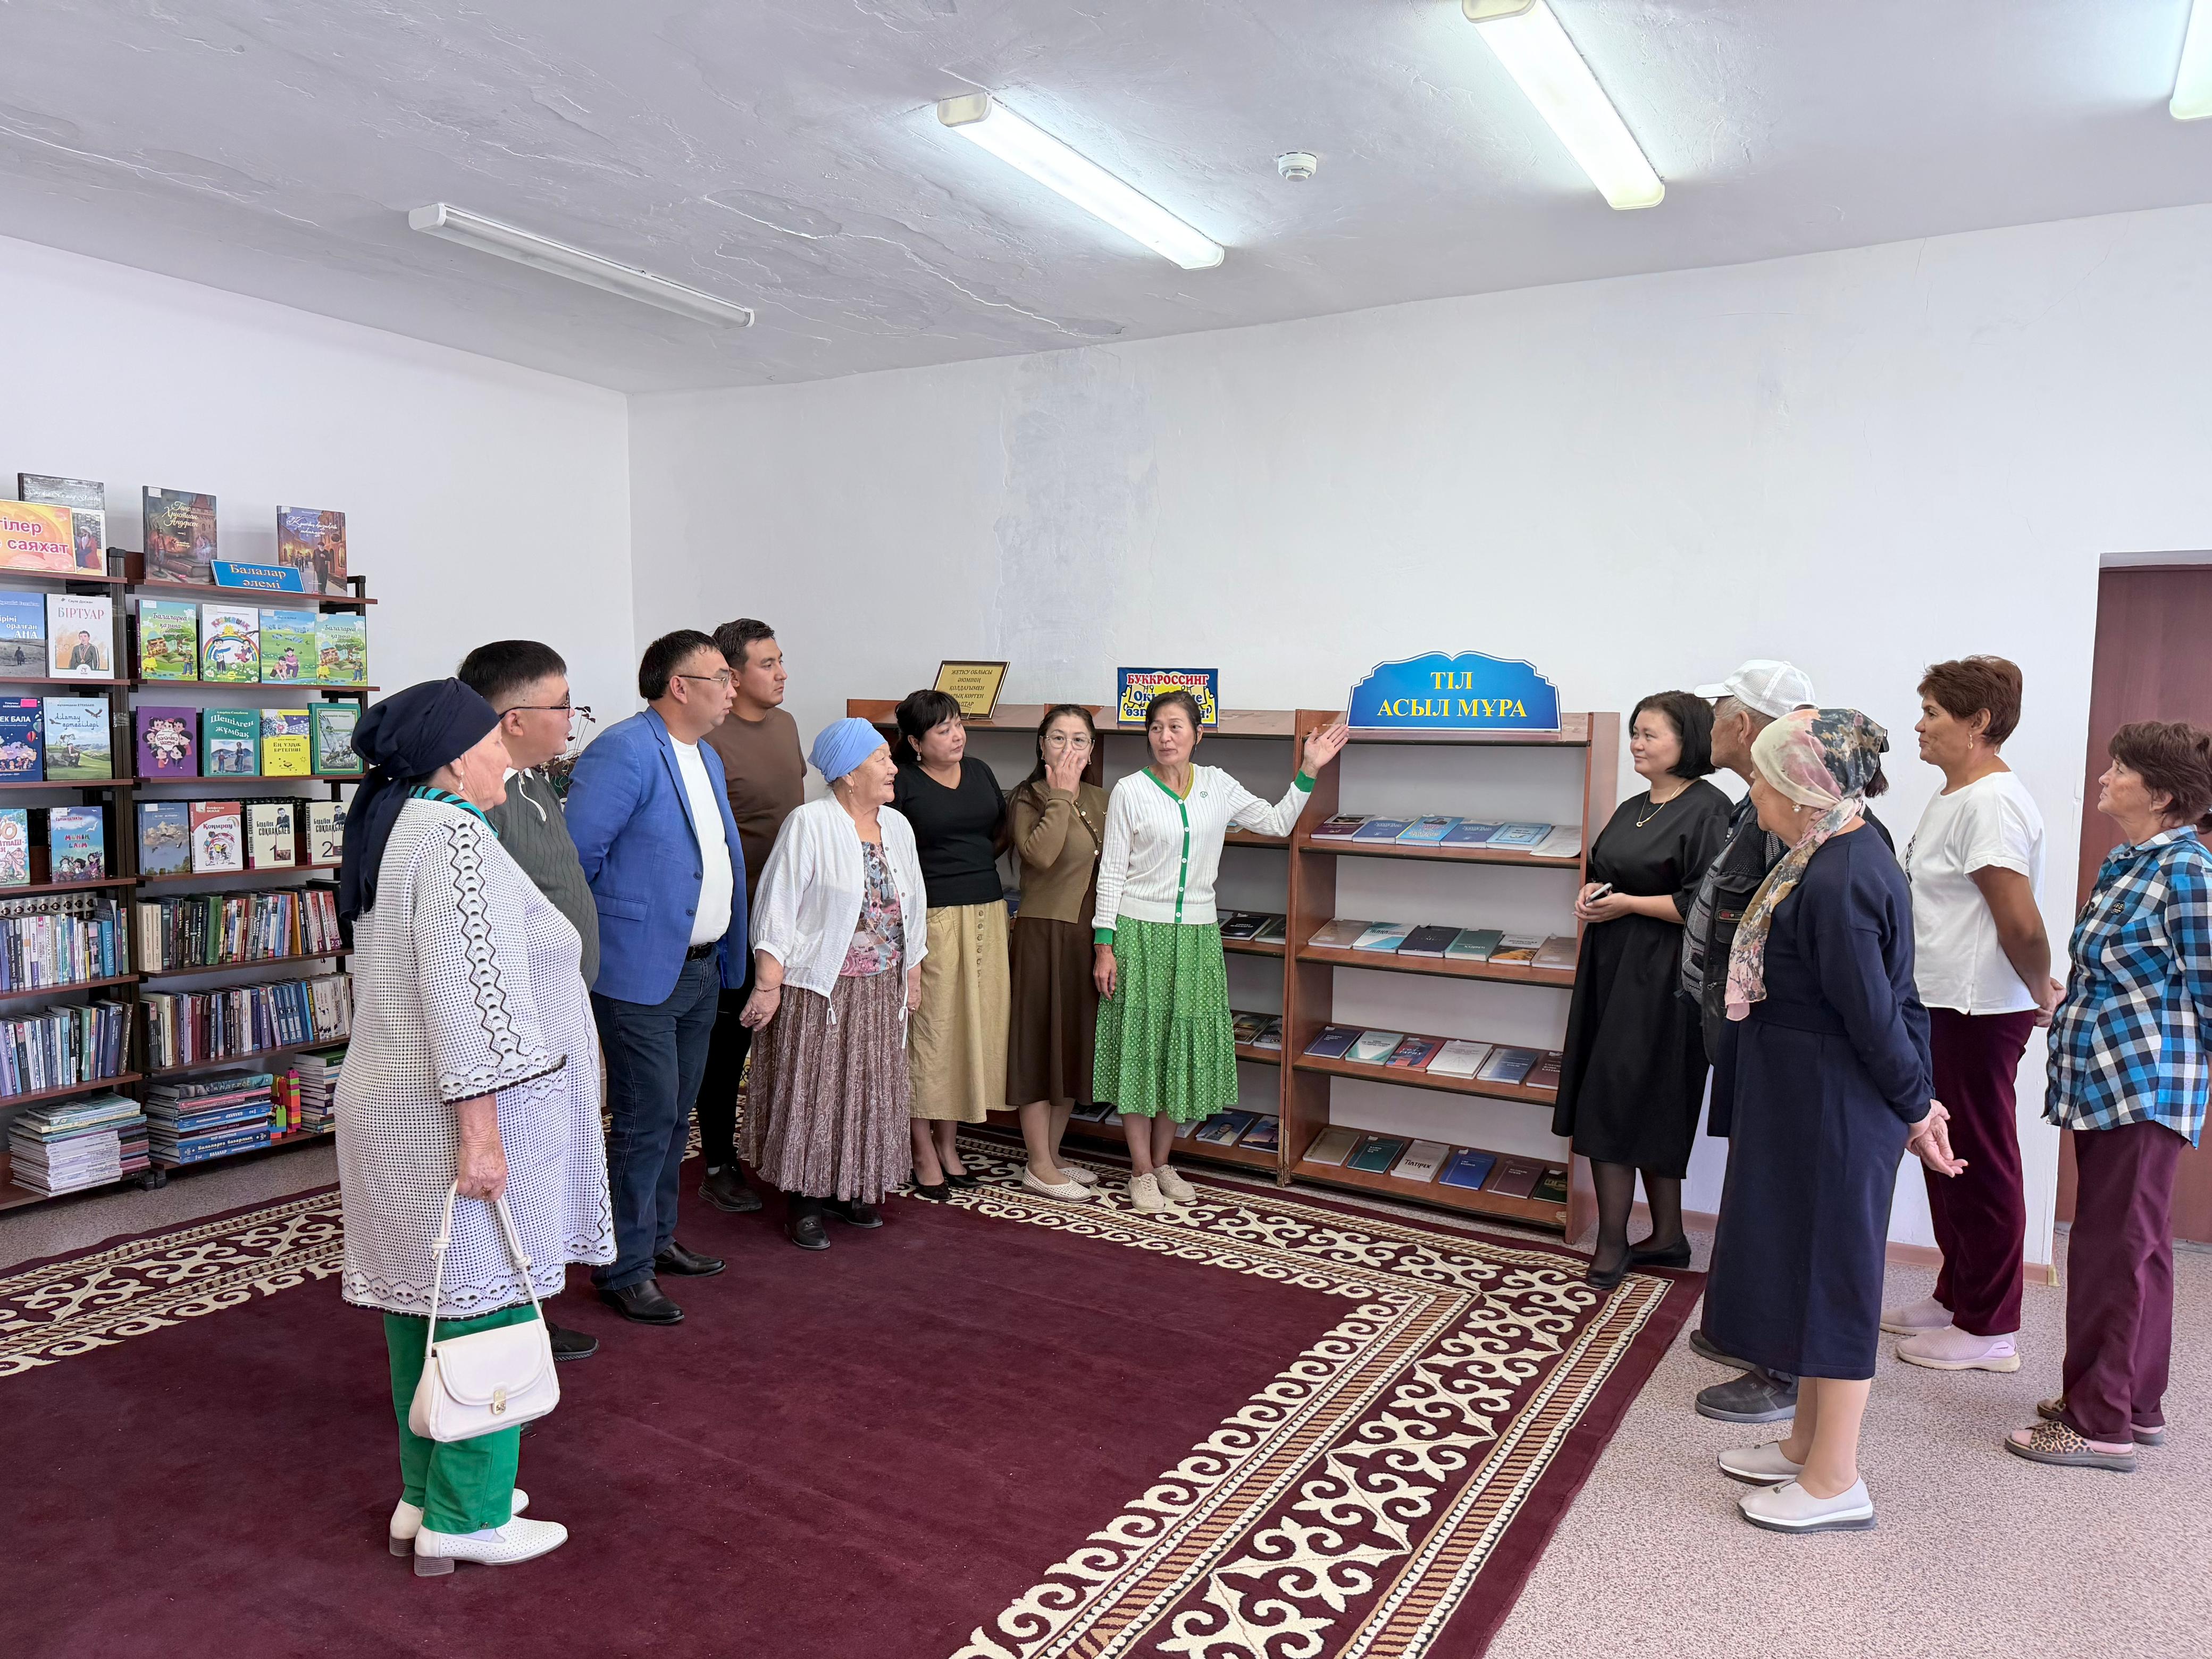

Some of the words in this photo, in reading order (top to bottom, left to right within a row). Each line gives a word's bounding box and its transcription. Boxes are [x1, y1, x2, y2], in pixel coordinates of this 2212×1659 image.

[7, 539, 68, 554] саяхат
[229, 564, 286, 580] Балалар
[242, 580, 281, 589] әлемі
[58, 607, 104, 619] БІРТУАР
[1127, 674, 1209, 685] БУККРОССИНГ
[1430, 672, 1474, 690] ТІЛ
[1377, 699, 1450, 717] АСЫЛ
[1456, 699, 1528, 717] МҰРА
[211, 715, 254, 728] Шешілген
[215, 726, 249, 739] жұмбақ
[258, 826, 291, 836] СОҚПАҚБАЕВ
[322, 841, 334, 858] 2
